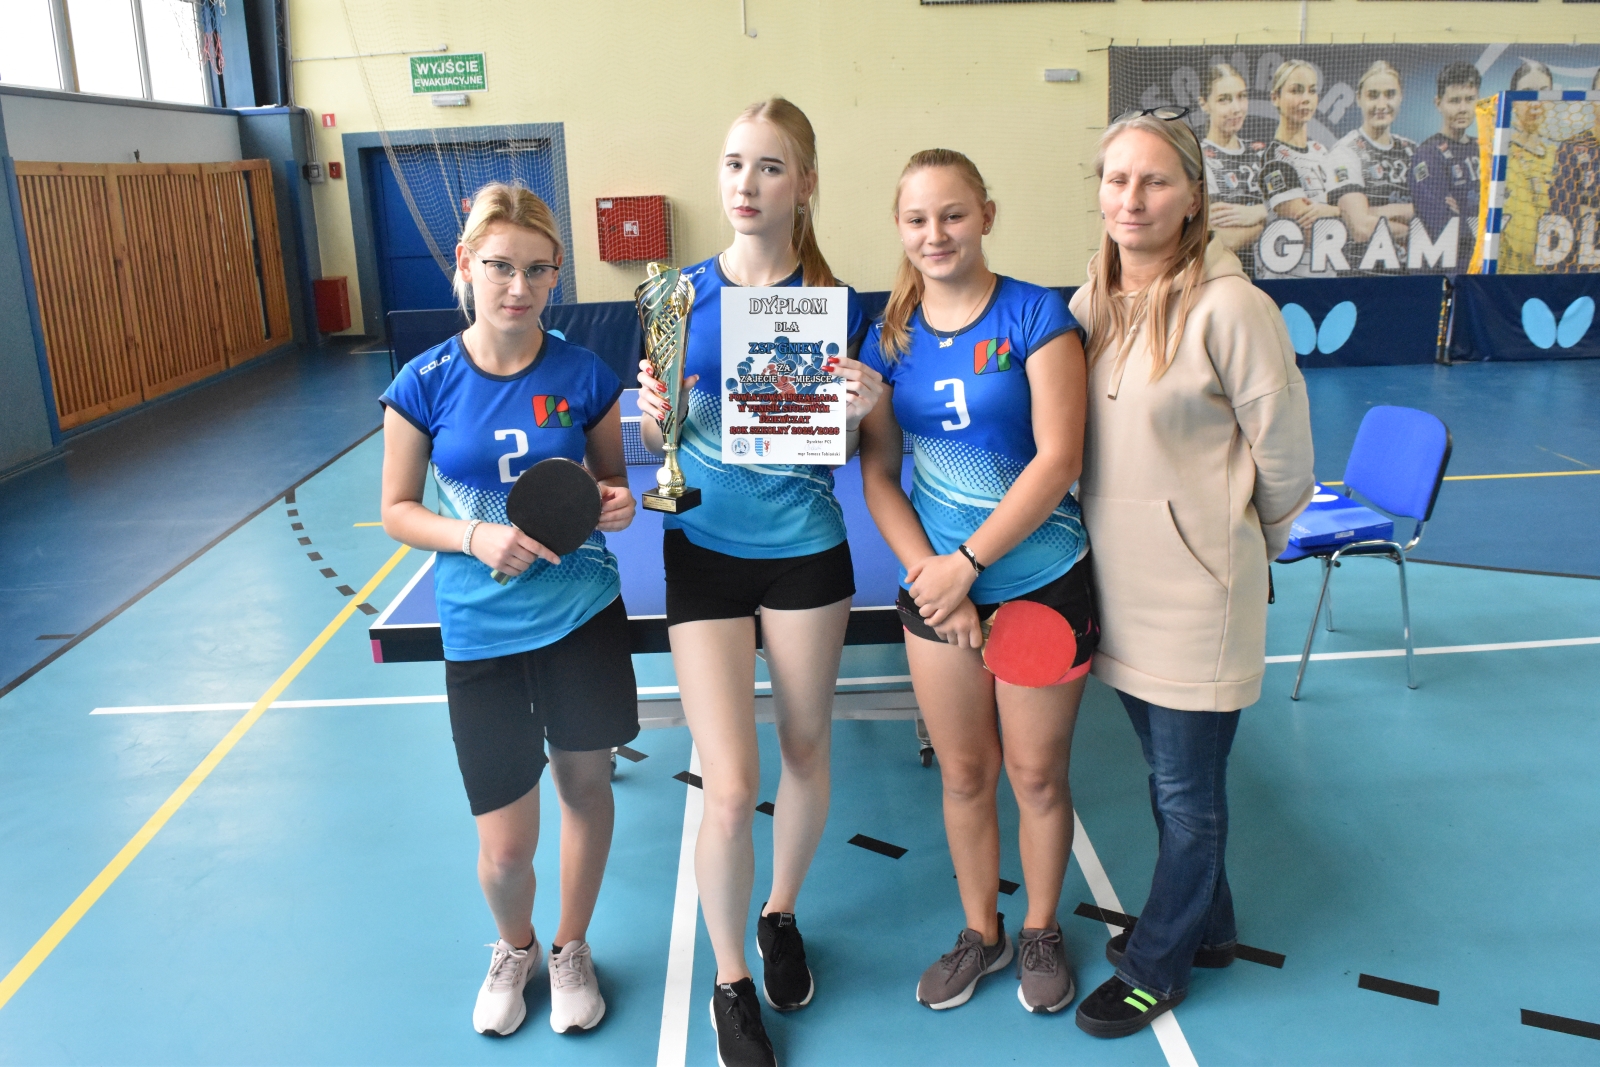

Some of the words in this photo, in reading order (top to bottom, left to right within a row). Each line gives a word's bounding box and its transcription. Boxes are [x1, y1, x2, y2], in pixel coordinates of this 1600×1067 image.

[416, 59, 479, 75] WYJŚCIE
[414, 74, 483, 87] EWAKUACYJNE
[749, 295, 828, 314] DYPLOM
[774, 322, 800, 332] DLA
[748, 342, 775, 354] ZSP
[777, 340, 823, 354] GNIEW
[419, 355, 451, 375] COLO
[777, 363, 792, 373] ZA
[795, 375, 832, 383] MIEJSCE
[729, 393, 785, 402] POWIATOWA
[737, 404, 748, 413] W
[748, 404, 781, 413] TENISIE
[934, 378, 971, 431] 3
[730, 425, 749, 435] ROK
[750, 425, 791, 435] SZKOLNY
[791, 426, 840, 436] 2025/2026
[494, 428, 529, 483] 2
